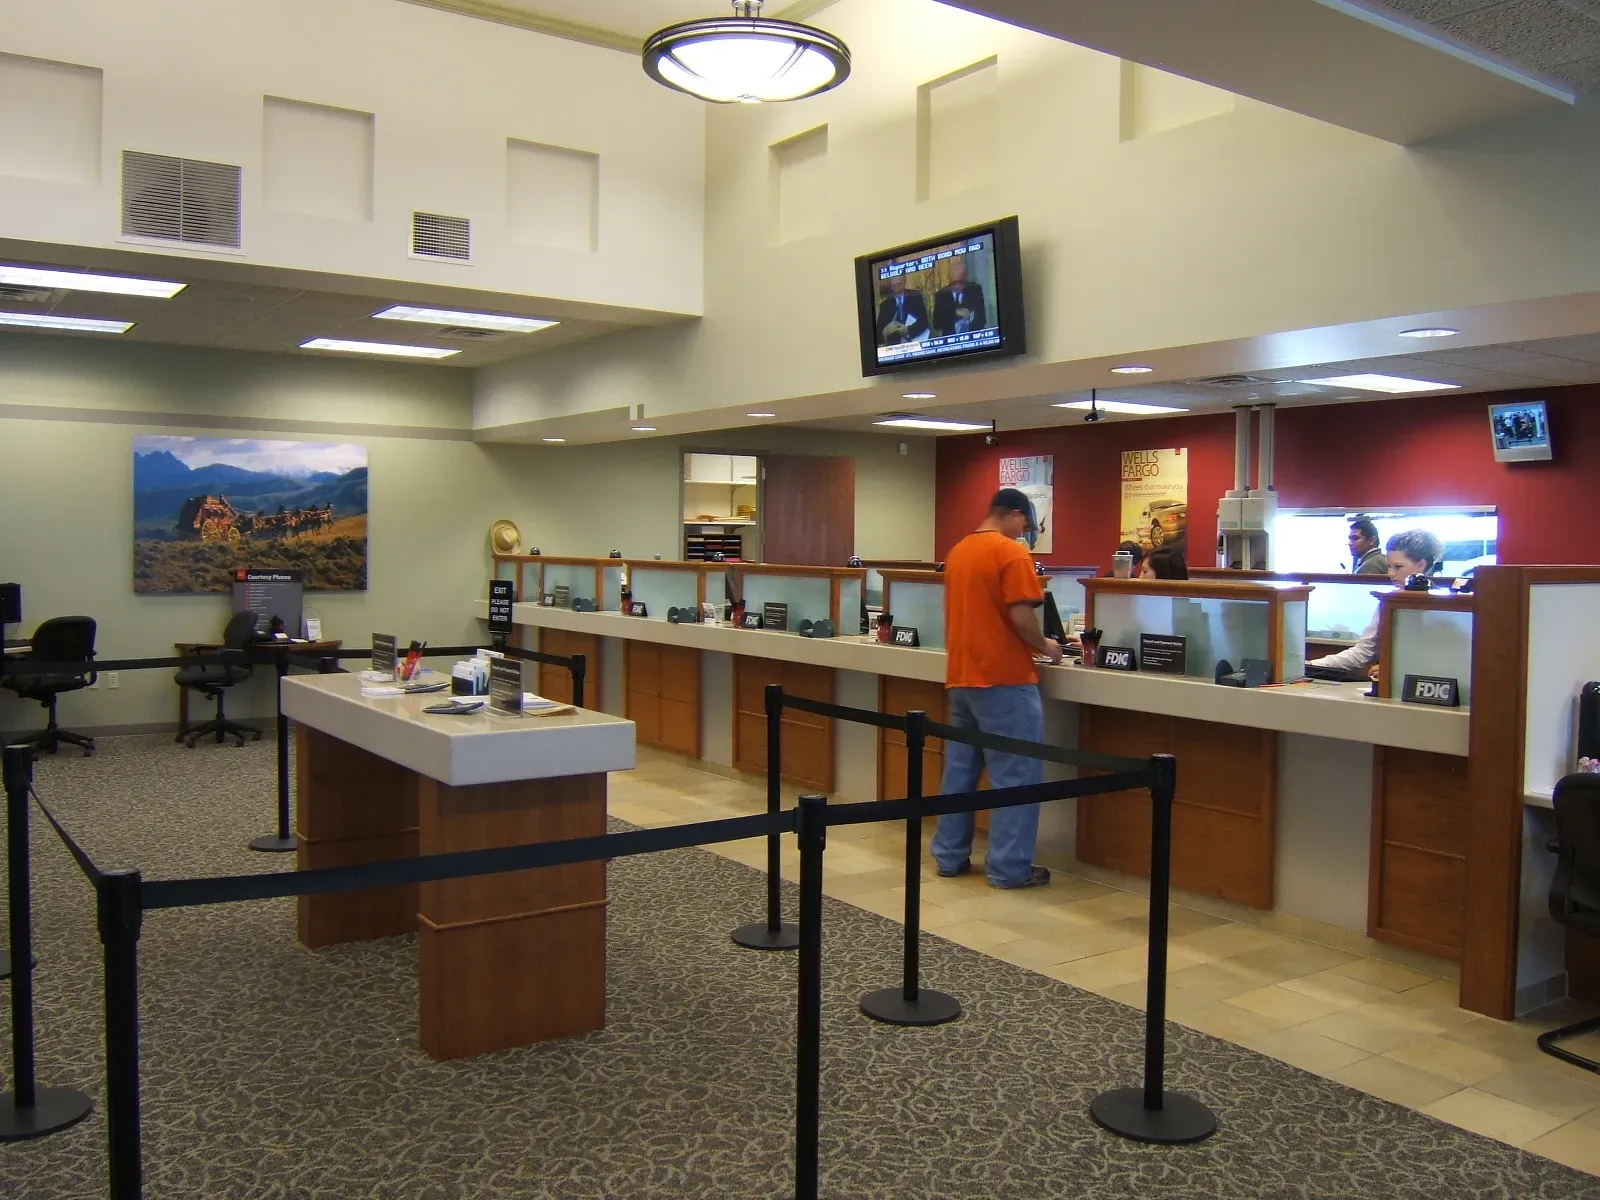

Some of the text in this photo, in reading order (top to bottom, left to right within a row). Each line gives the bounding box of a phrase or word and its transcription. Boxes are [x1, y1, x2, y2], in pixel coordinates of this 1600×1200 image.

[889, 260, 919, 271] Reporter:
[1123, 451, 1159, 465] WELLS
[1000, 458, 1029, 471] WELLS
[1000, 470, 1031, 482] FARGO
[1123, 464, 1159, 478] FARGO
[1171, 484, 1183, 492] you
[493, 586, 507, 594] EXIT
[491, 598, 510, 606] PLEASE
[745, 615, 759, 626] FDIC
[895, 631, 914, 643] FDIC
[1105, 652, 1129, 666] FDIC
[1415, 682, 1450, 699] FDIC
